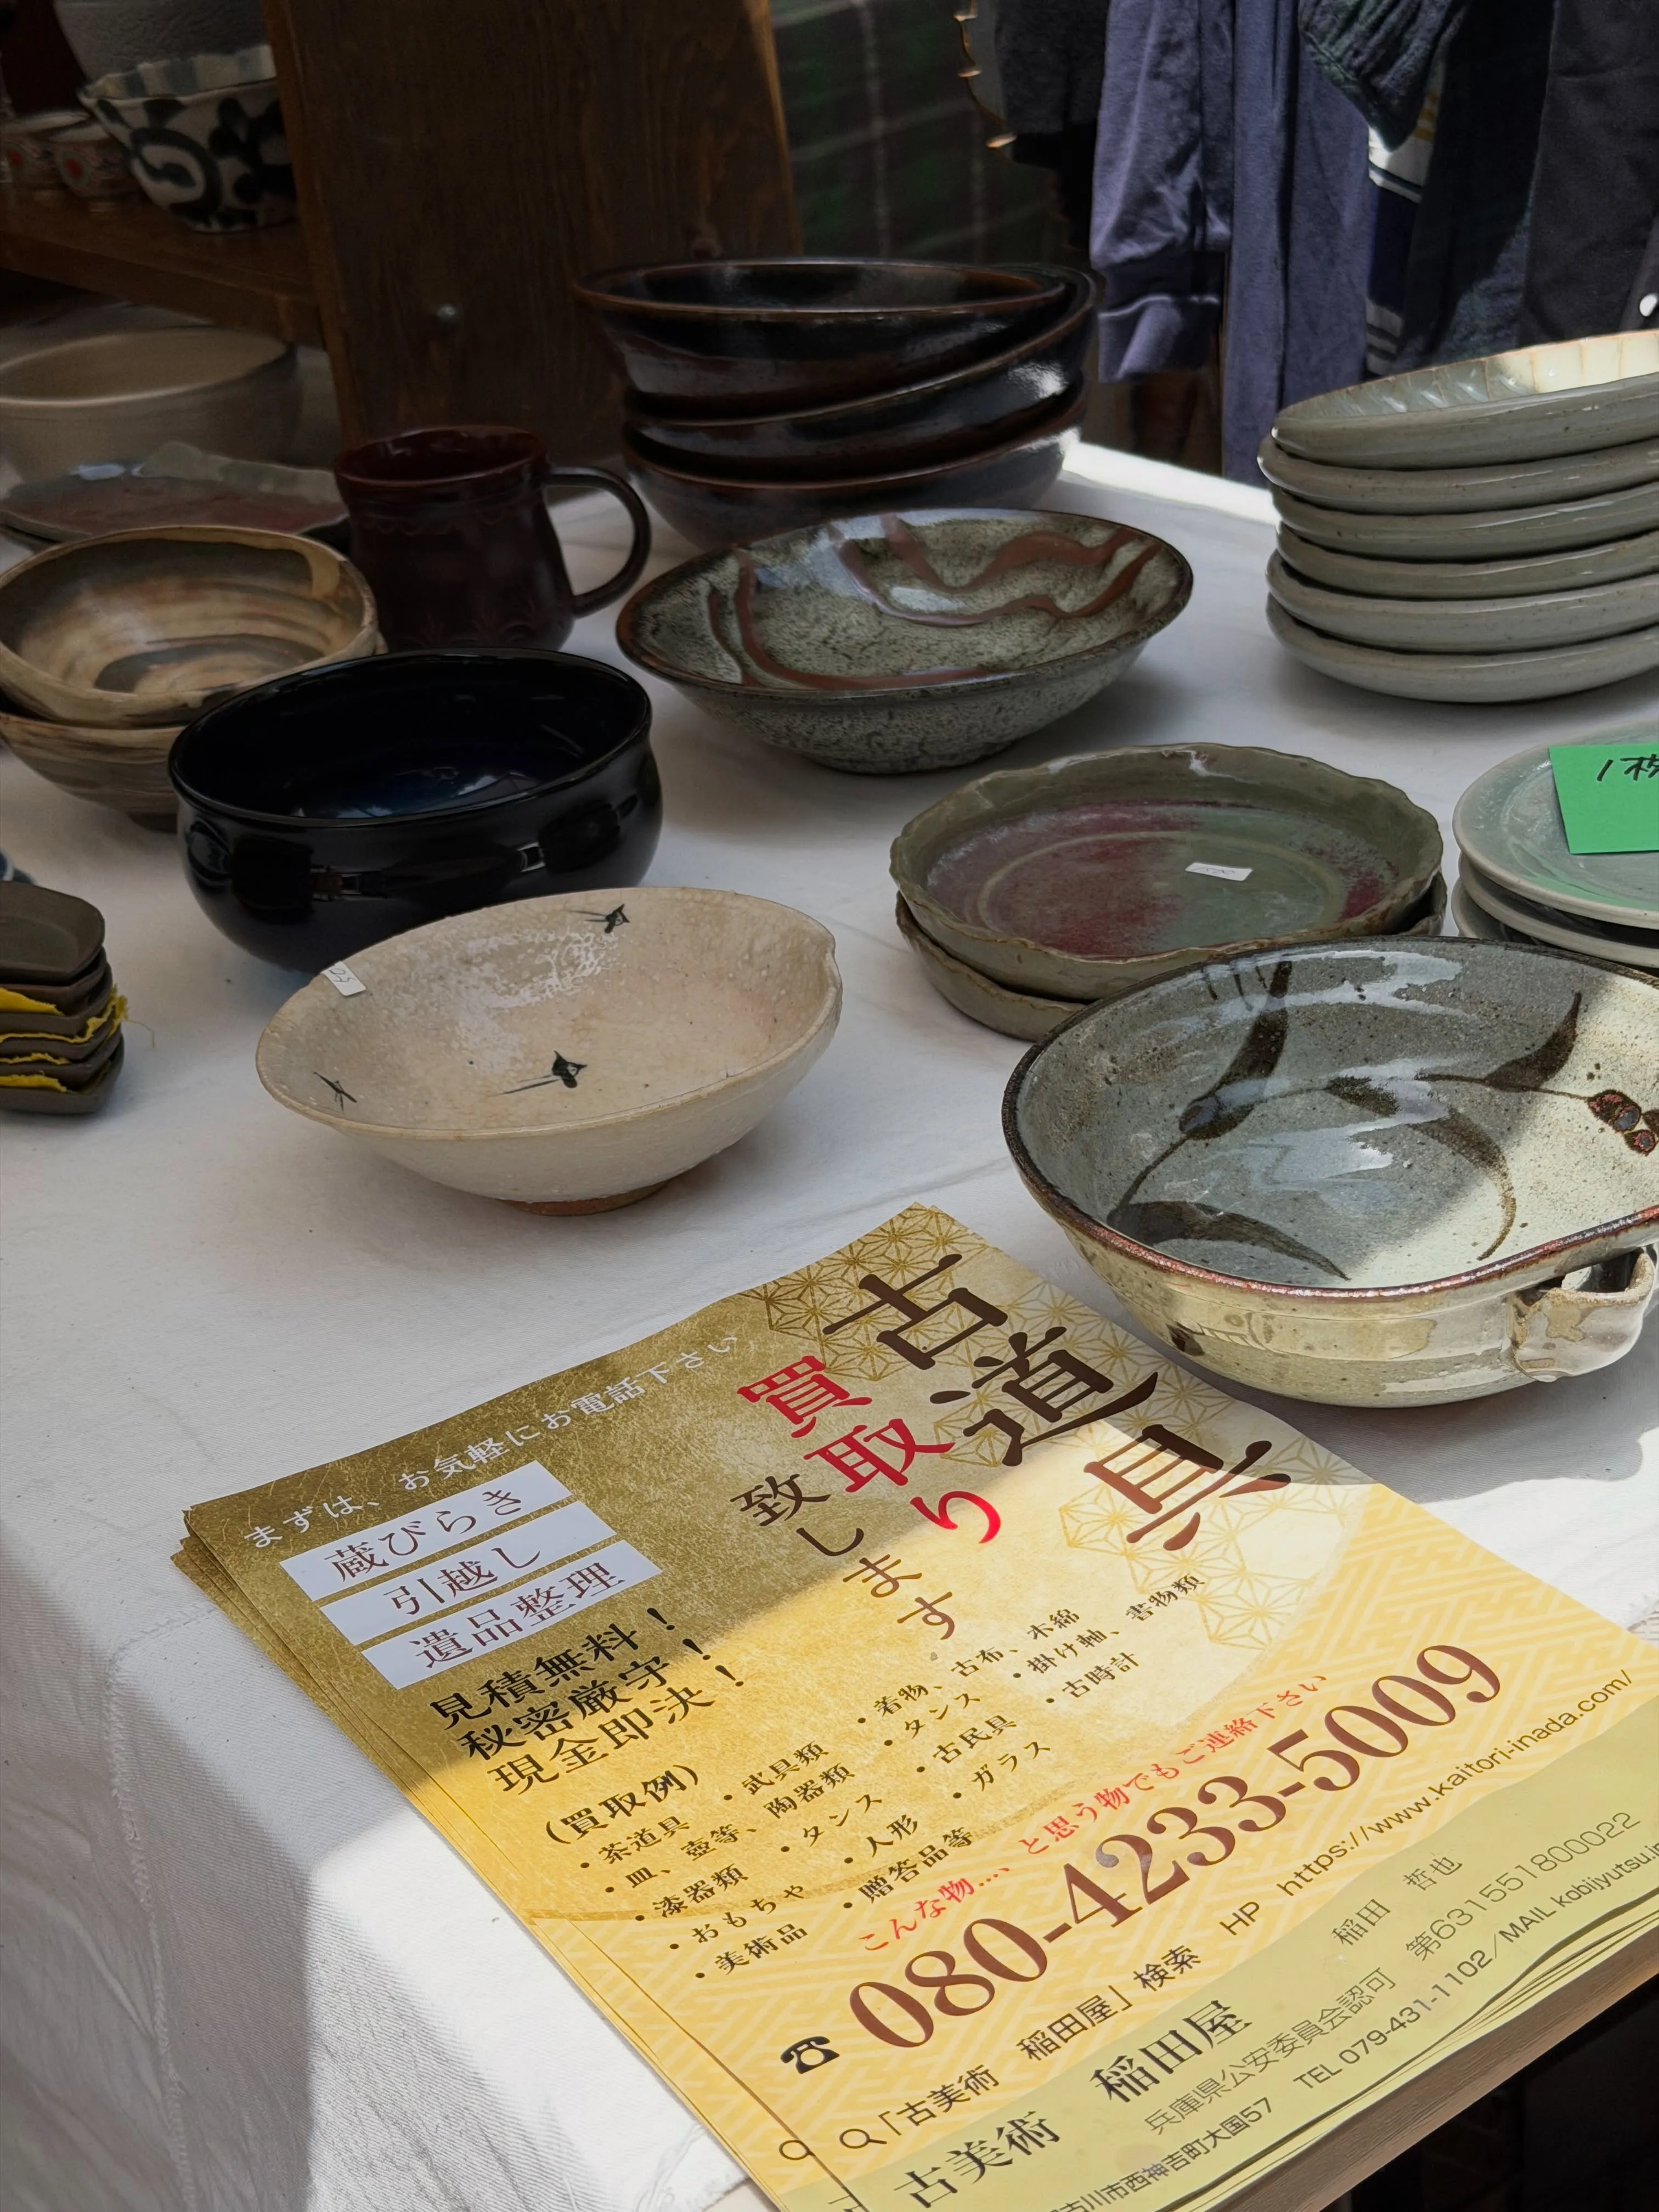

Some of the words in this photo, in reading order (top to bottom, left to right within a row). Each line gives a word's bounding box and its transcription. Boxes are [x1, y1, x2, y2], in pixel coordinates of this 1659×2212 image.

[737, 1355, 1001, 1543] 買取り
[822, 1253, 1291, 1550] 古道具
[324, 1488, 527, 1582] 蔵びらき
[383, 1546, 541, 1615] 引越し
[409, 1561, 625, 1668] 遺品整理
[730, 1474, 956, 1640] 致します
[850, 1645, 1500, 2047] 080-4233-5009
[1219, 1901, 1261, 1936] HP
[1277, 1669, 1633, 1897] https://www.kaitori-inada.com/
[1144, 1967, 1396, 2135] 兵庫県公安委員会認可
[1406, 1812, 1640, 1961] 第631551800022
[894, 2111, 1060, 2208] 古美術
[1090, 2000, 1252, 2103] 稲田屋
[1293, 2064, 1343, 2089] TEL
